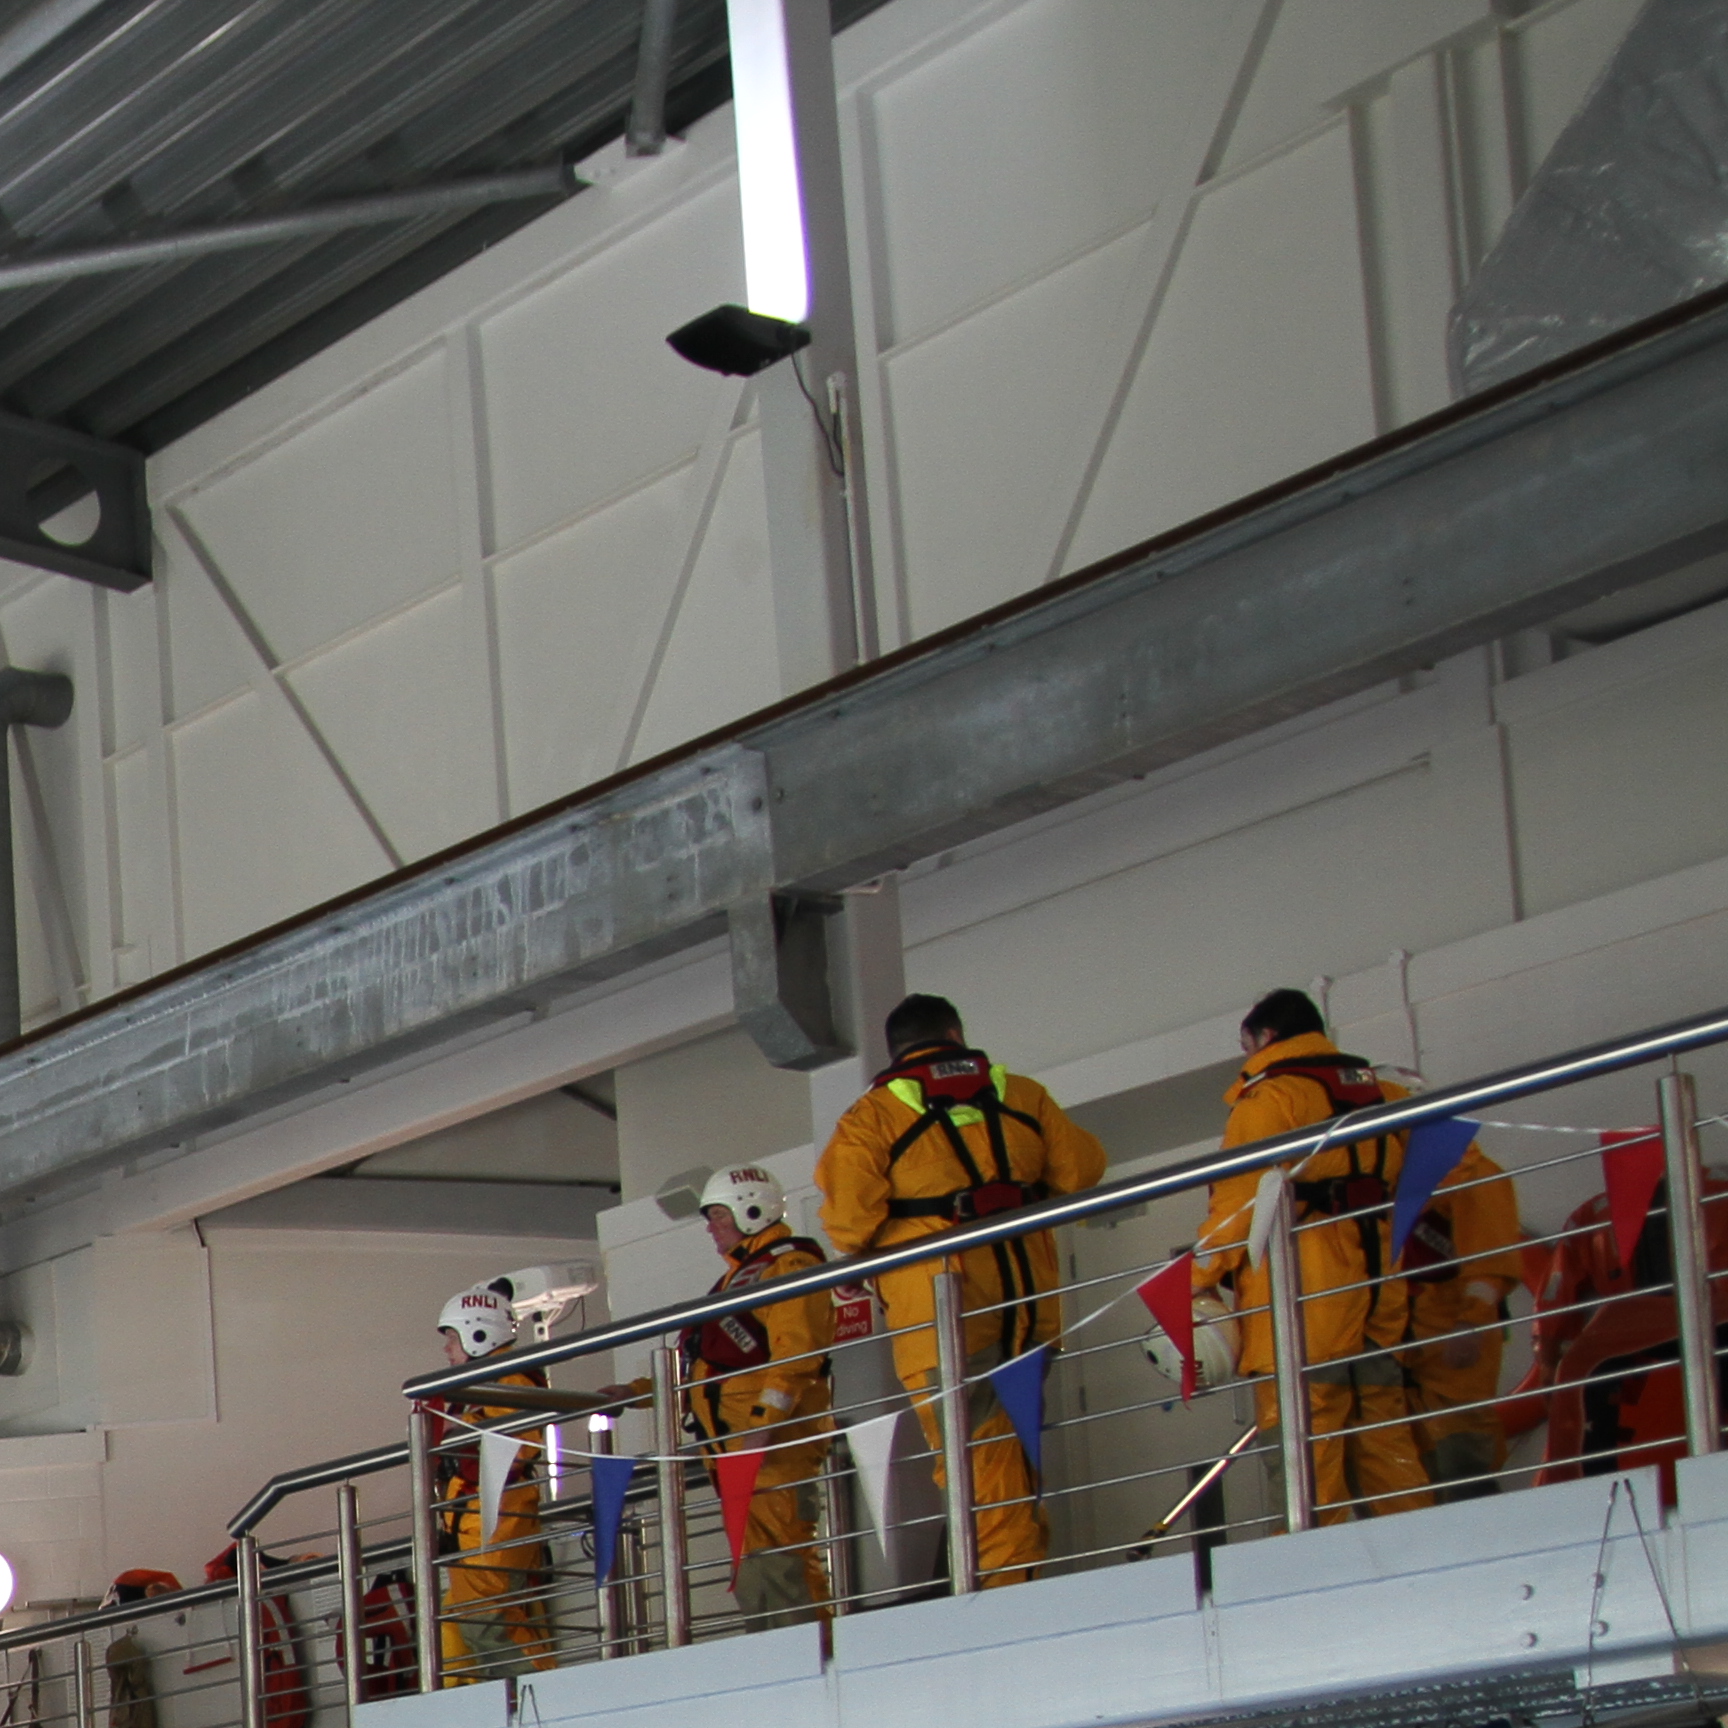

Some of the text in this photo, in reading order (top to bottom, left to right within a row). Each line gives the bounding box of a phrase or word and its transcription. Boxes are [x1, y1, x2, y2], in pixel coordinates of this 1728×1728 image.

[729, 1168, 770, 1185] RNLI
[461, 1294, 497, 1309] RNLI
[843, 1306, 860, 1318] No
[723, 1314, 756, 1352] RNLI
[836, 1320, 868, 1337] diving
